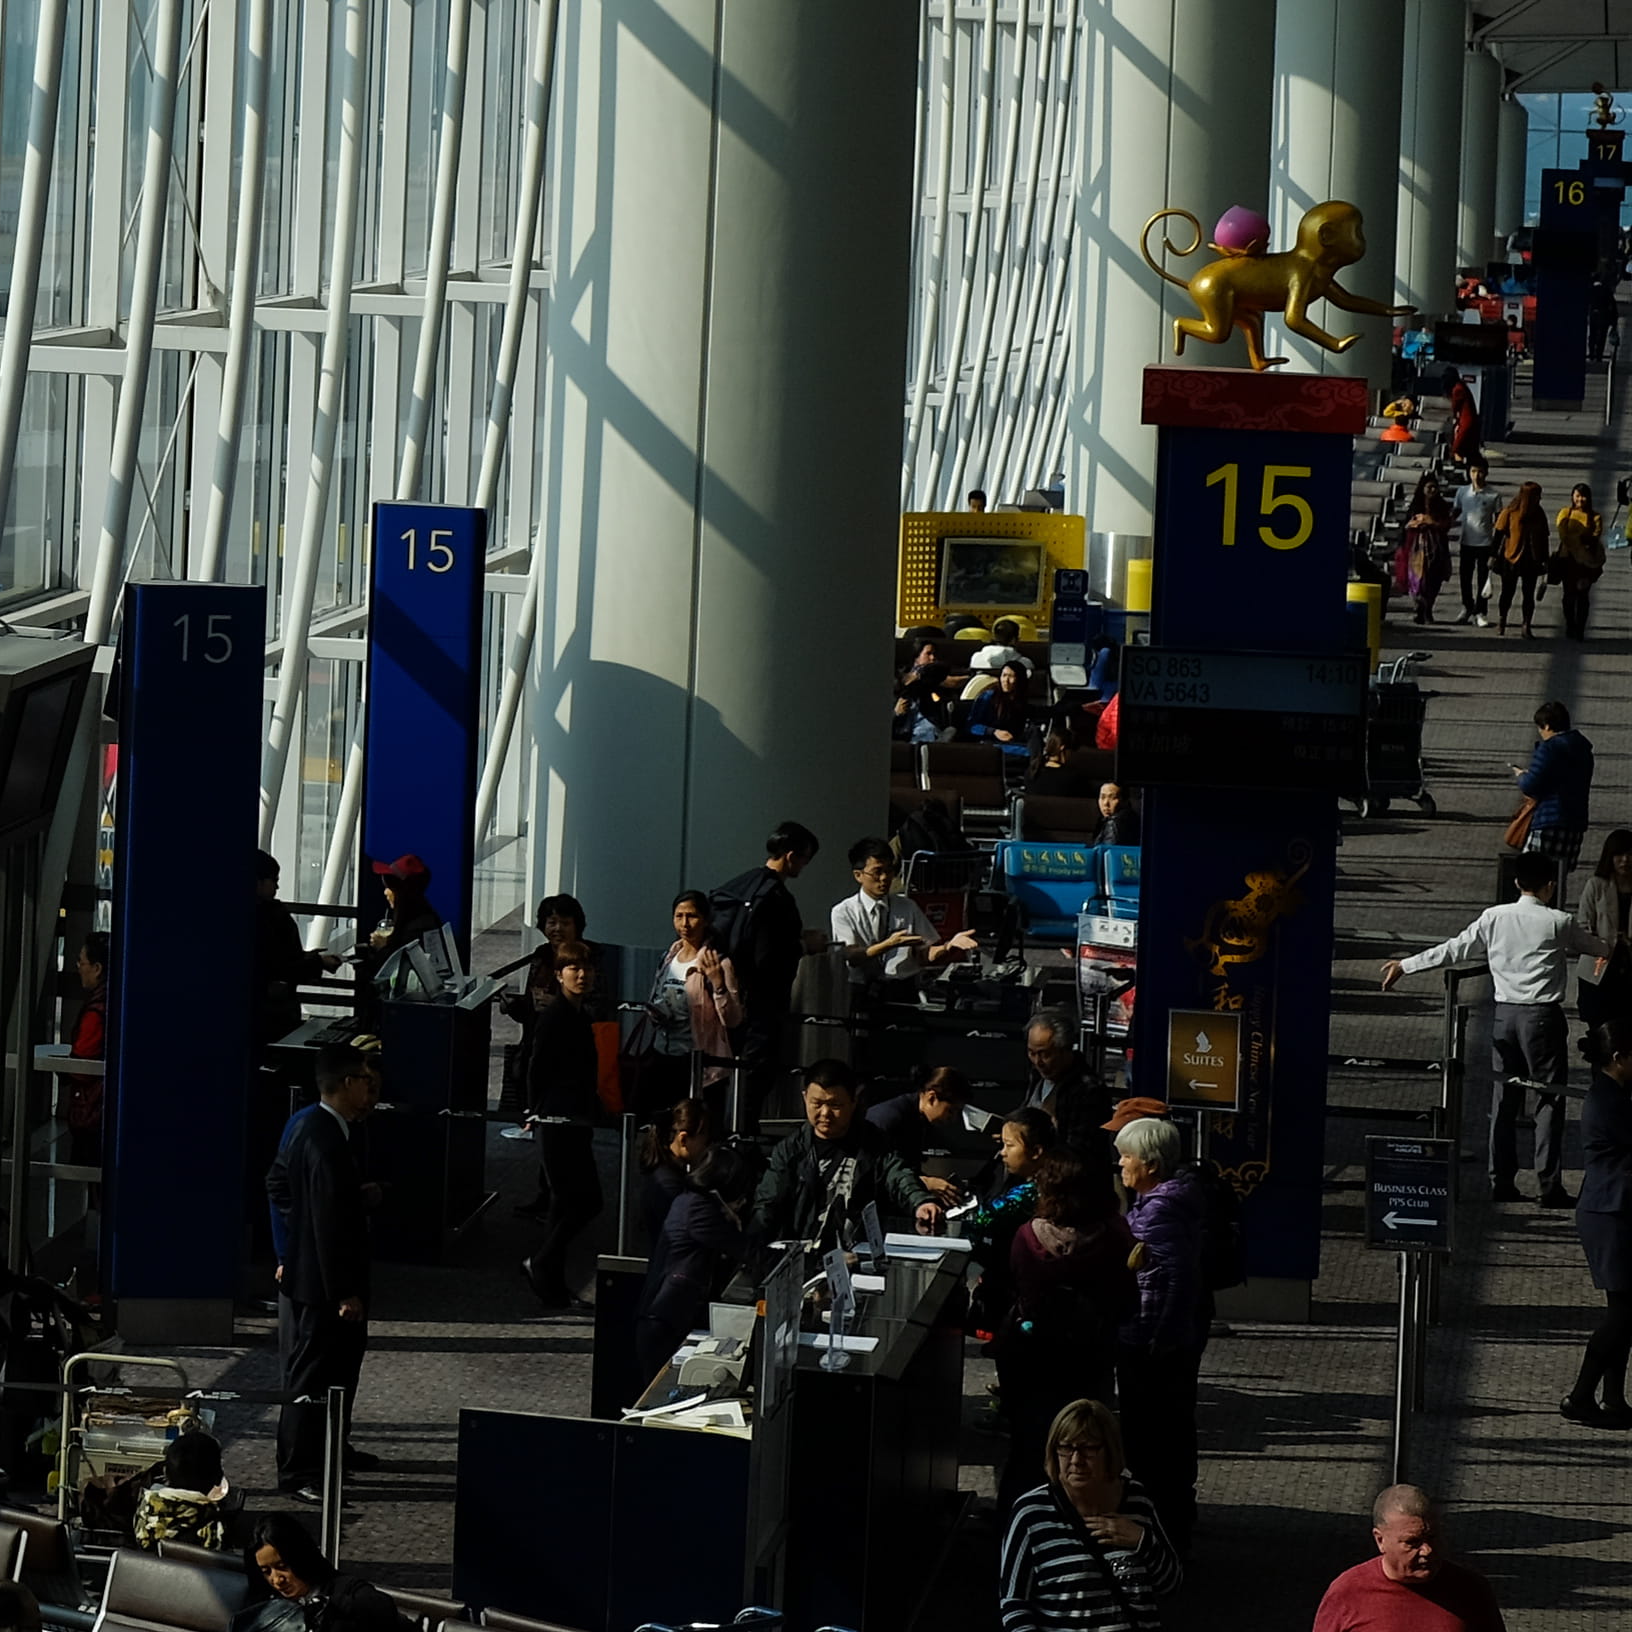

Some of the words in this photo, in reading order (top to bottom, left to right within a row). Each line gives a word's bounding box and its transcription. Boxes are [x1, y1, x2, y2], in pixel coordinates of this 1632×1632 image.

[1595, 144, 1617, 161] 17
[1553, 180, 1585, 206] 16
[1205, 462, 1315, 551] 15
[400, 528, 455, 574] 15
[172, 614, 234, 665] 15
[1130, 656, 1161, 676] SQ
[1167, 657, 1202, 678] 863
[1305, 663, 1358, 685] 14:10
[1129, 679, 1158, 701] VA
[1164, 681, 1210, 704] 5643
[1183, 1052, 1225, 1068] SUITES
[1249, 1031, 1264, 1081] Chinese
[1248, 1090, 1262, 1115] New
[1374, 1183, 1417, 1195] BUSINESS
[1418, 1185, 1448, 1197] CLASS
[1389, 1197, 1405, 1207] PPS
[1407, 1198, 1430, 1208] CLUB
